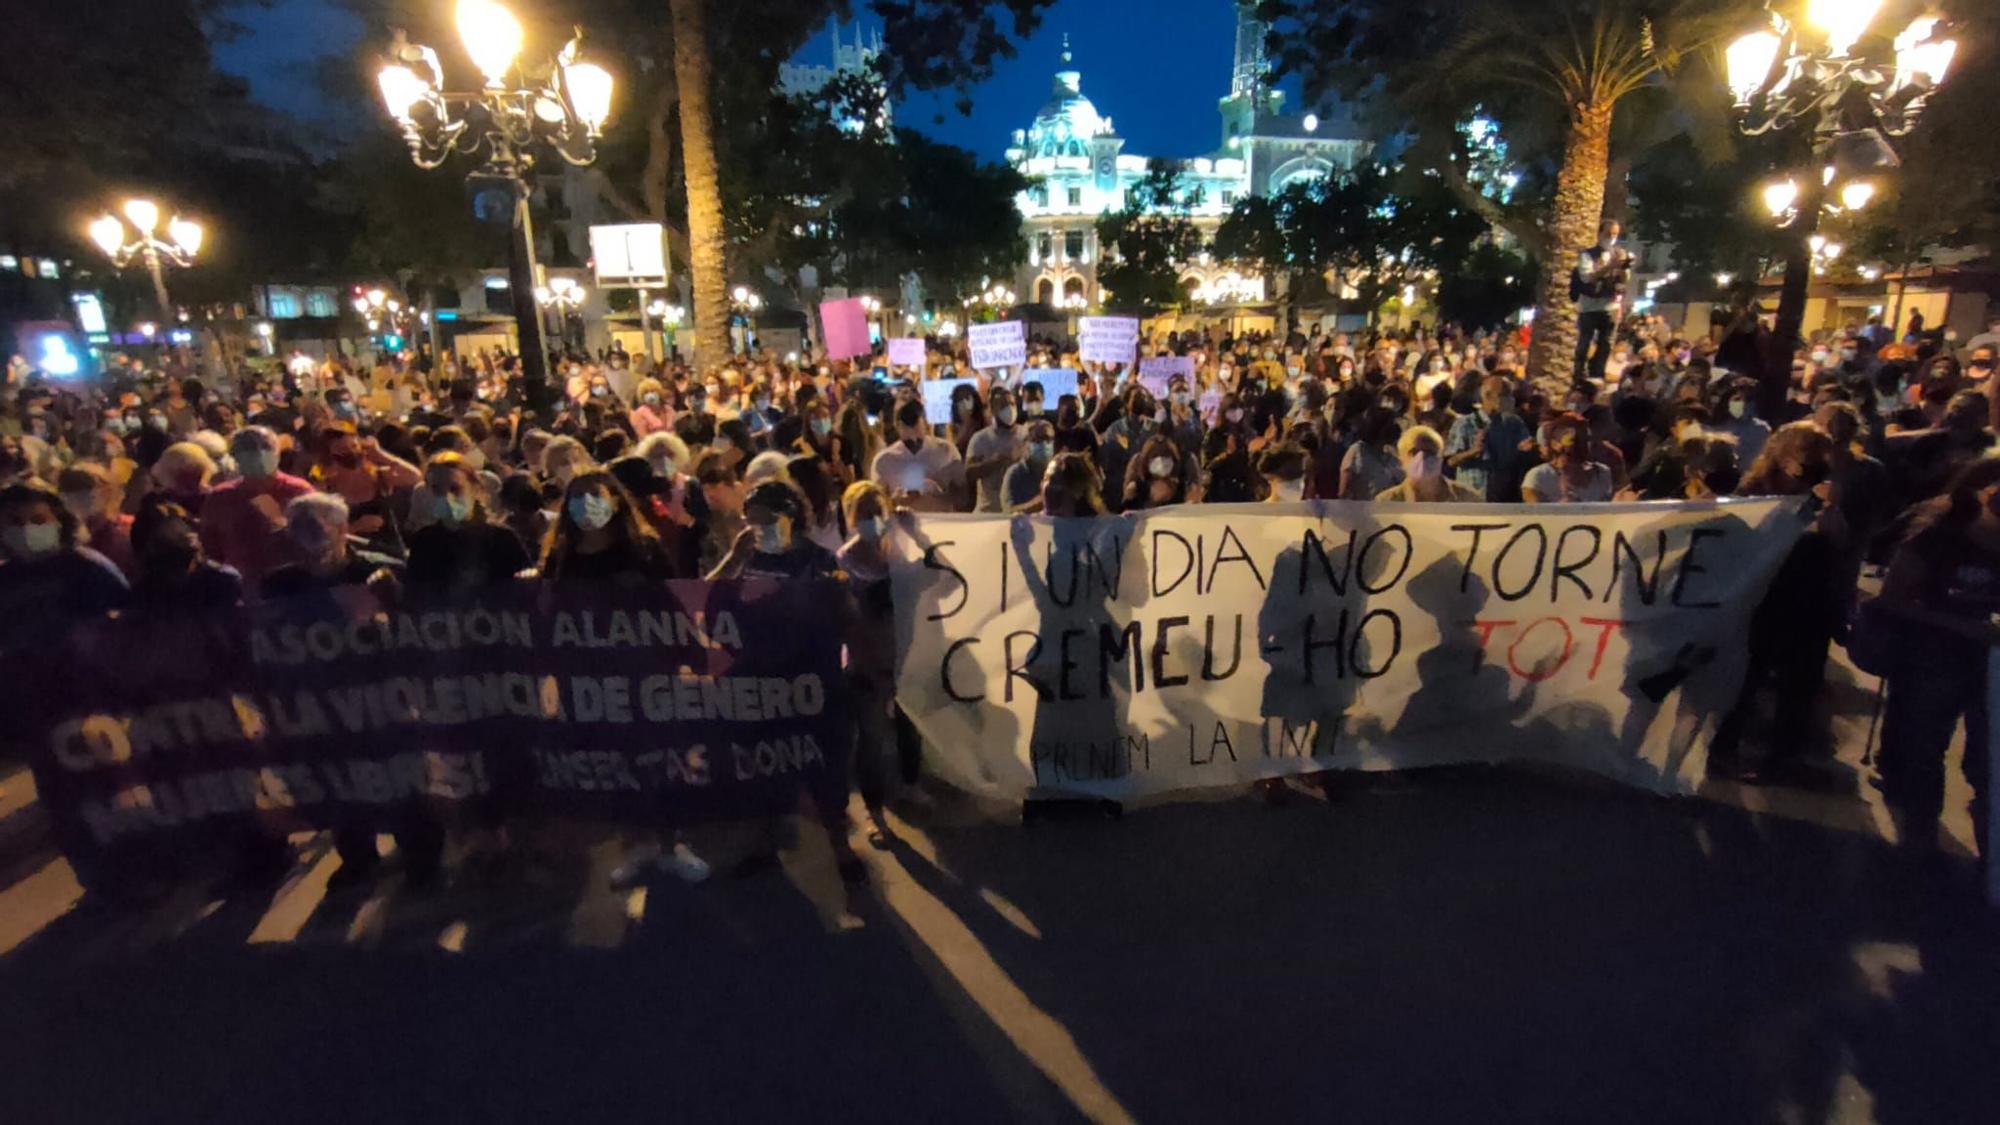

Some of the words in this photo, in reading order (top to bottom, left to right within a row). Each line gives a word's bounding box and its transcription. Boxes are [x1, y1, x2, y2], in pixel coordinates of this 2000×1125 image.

[1043, 534, 1121, 605] UN
[1150, 526, 1267, 598] DIA
[1298, 522, 1413, 598] NO
[1450, 519, 1727, 608] TORNE
[552, 608, 743, 650] ALANNA
[939, 607, 1403, 705] CREMEU-HO
[1473, 614, 1629, 682] TOT
[267, 689, 331, 737] LA
[571, 675, 634, 722] DE
[731, 733, 825, 782] DONA
[1188, 719, 1237, 767] LA
